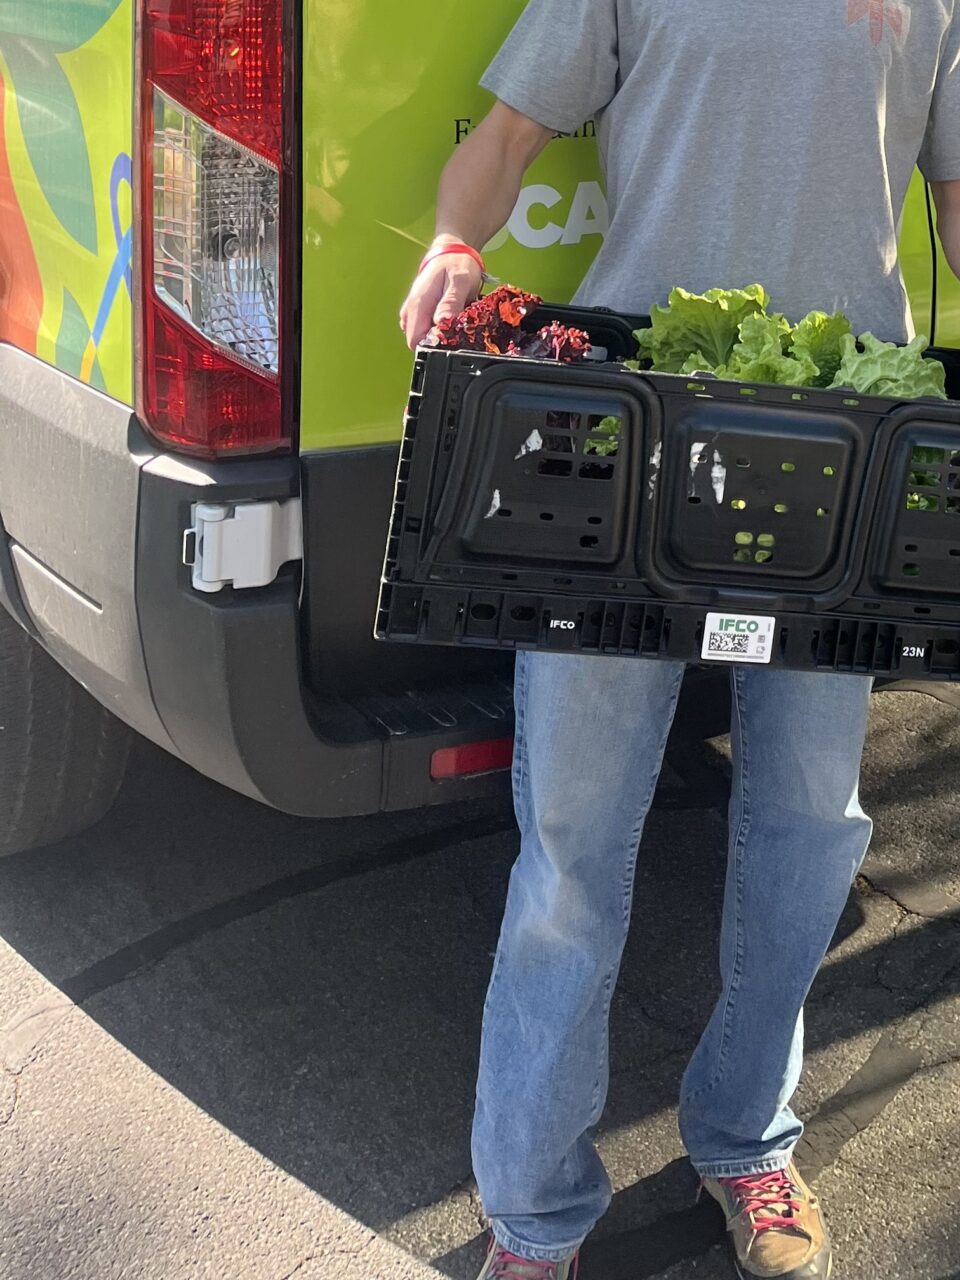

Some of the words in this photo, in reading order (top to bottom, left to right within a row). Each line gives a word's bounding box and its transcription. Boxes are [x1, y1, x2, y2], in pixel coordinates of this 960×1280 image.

[550, 620, 576, 629] IFCO
[719, 618, 759, 633] IFCO
[902, 646, 925, 658] 23N
